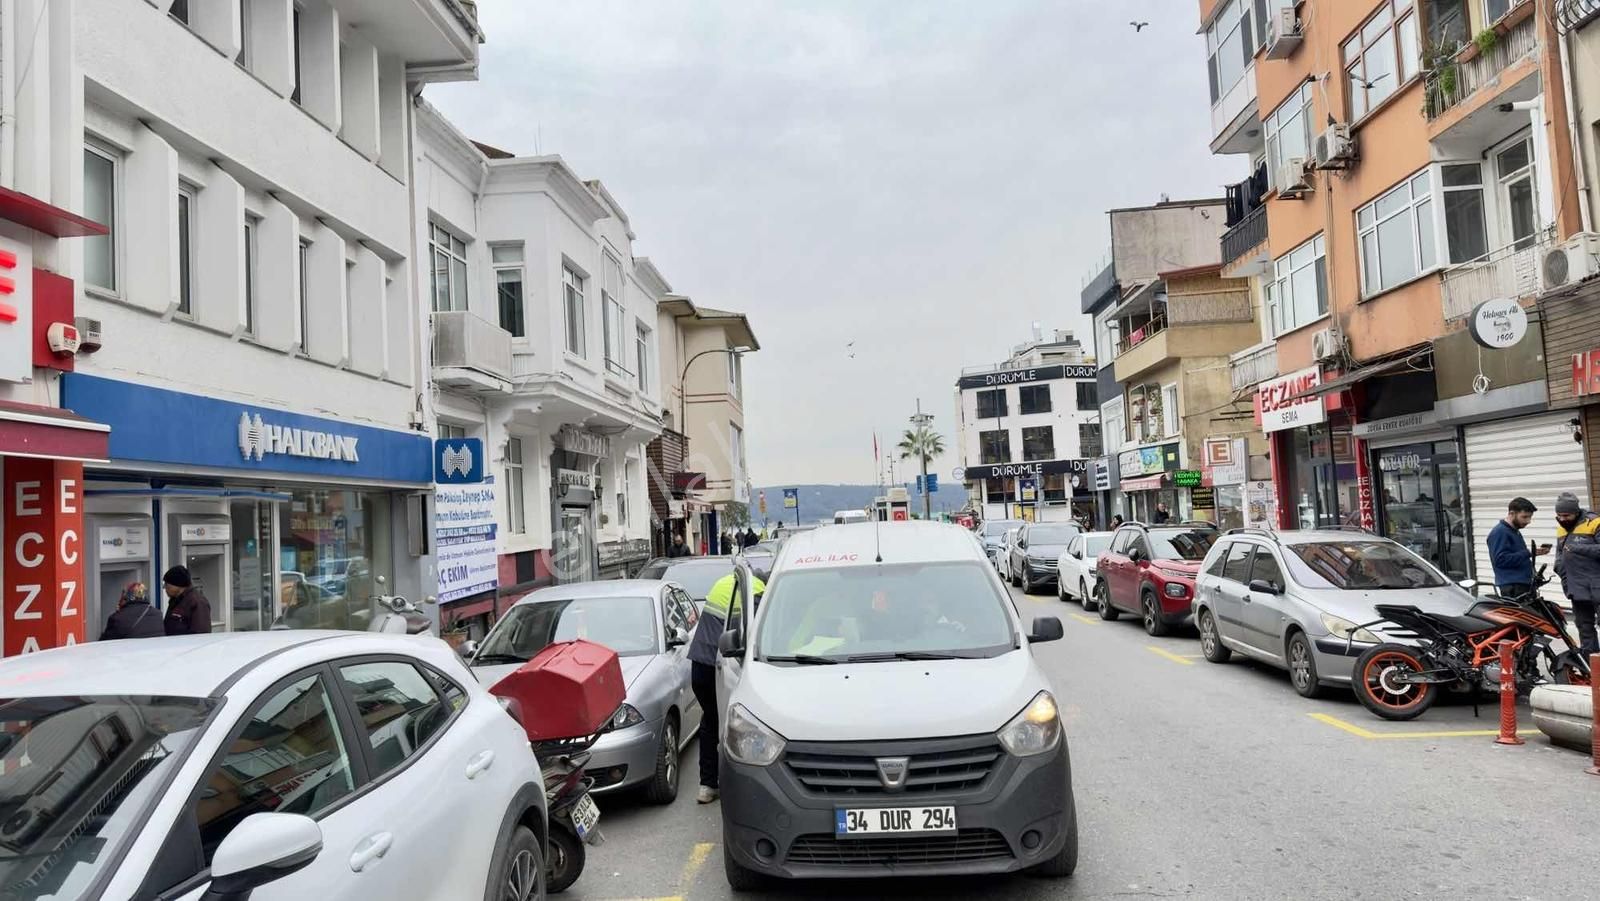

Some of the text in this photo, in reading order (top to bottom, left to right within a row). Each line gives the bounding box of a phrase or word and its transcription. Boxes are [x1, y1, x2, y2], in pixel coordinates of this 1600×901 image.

[986, 370, 1036, 385] DÜRÜMLE
[1261, 373, 1318, 413] ECZANE
[1282, 411, 1298, 424] SEMA
[264, 424, 359, 462] HALKBANK
[992, 463, 1042, 477] DÜRÜMLE
[448, 562, 468, 583] EKİM
[847, 810, 868, 831] 34
[880, 810, 912, 831] DUR
[922, 808, 954, 829] 294
